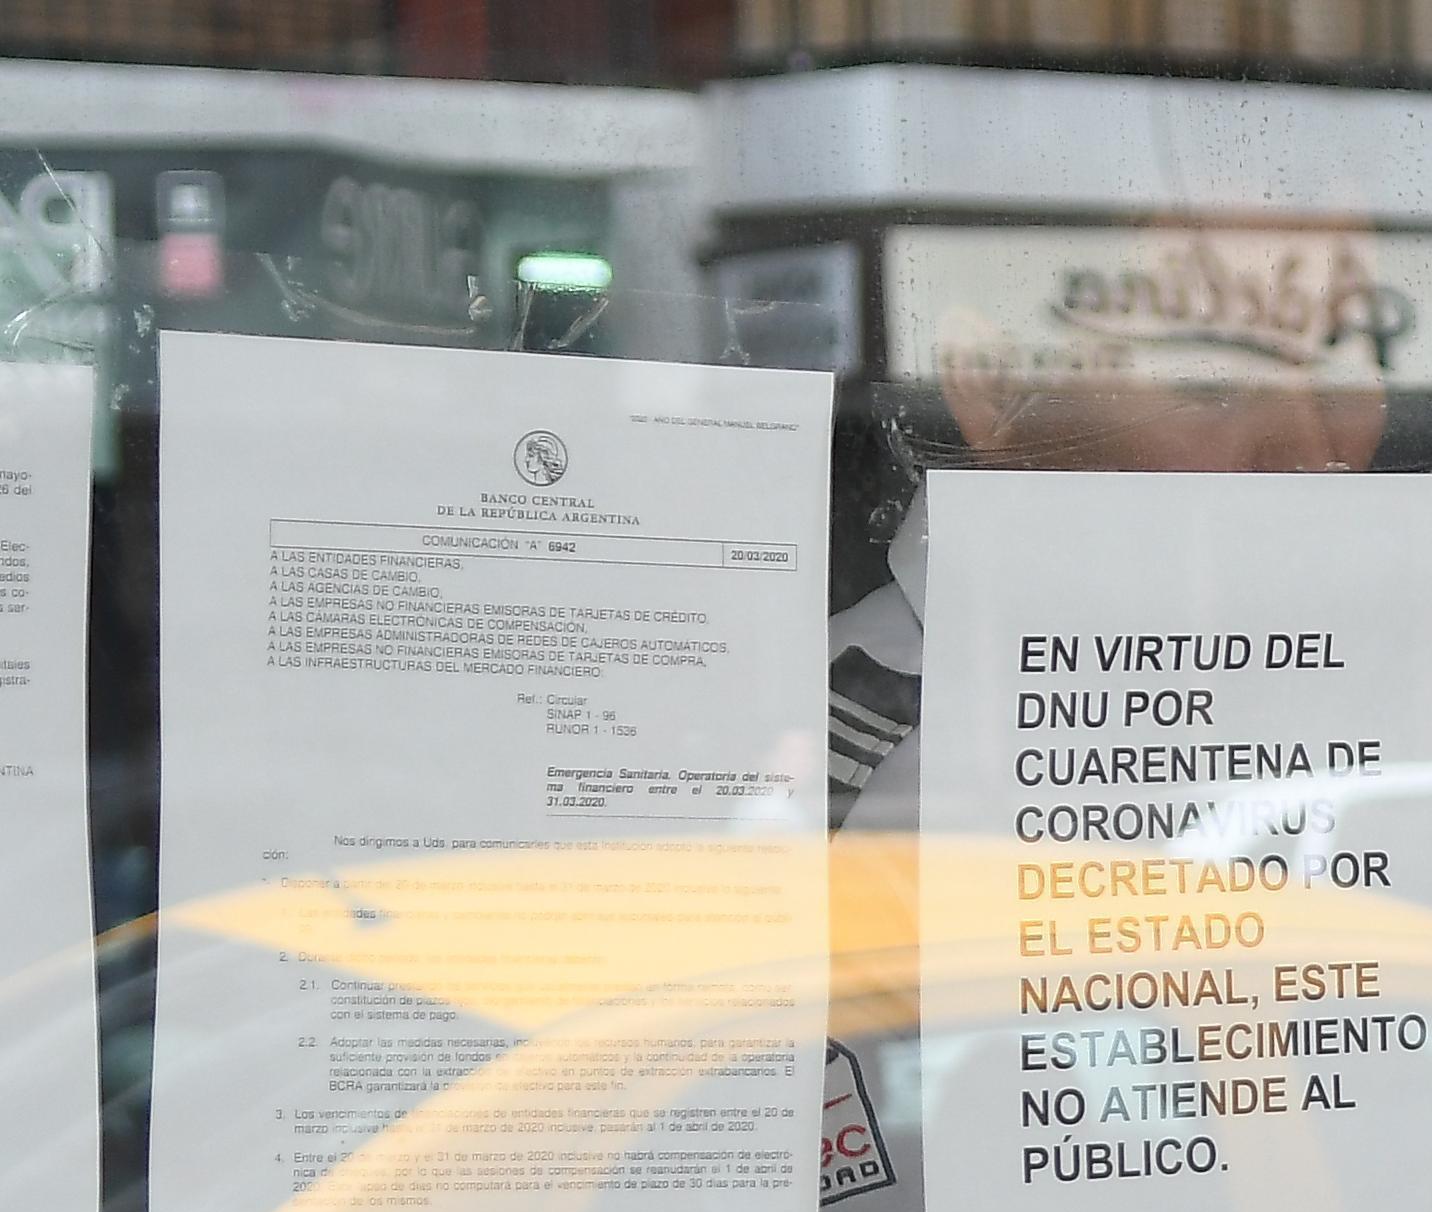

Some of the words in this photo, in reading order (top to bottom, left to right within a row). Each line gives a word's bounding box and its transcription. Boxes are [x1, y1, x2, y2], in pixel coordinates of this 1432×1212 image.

[14, 484, 32, 495] del
[480, 493, 527, 505] BANCO
[531, 496, 595, 509] CENTRAL
[437, 505, 454, 516] DE
[459, 506, 476, 517] LA
[481, 506, 557, 521] REPÚBLICA
[561, 512, 640, 525] ARGENTINA
[422, 533, 519, 550] COMUNICACIÓN
[548, 542, 577, 553] 6942
[270, 551, 278, 561] A
[281, 551, 305, 562] LAS
[308, 552, 376, 565] ENTIDADES
[380, 556, 464, 570] FINANCIERAS,
[730, 550, 789, 563] 20/03/2020
[270, 566, 278, 577] A
[281, 567, 304, 578] LAS
[308, 568, 348, 579] CASAS
[352, 570, 368, 580] DE
[371, 570, 422, 584] CAMBIO,
[270, 582, 278, 592] A
[280, 582, 304, 593] LAS
[308, 583, 370, 596] AGENCIAS
[372, 586, 389, 596] DE
[392, 586, 443, 599] CAMBIO,
[268, 596, 277, 606] A
[280, 596, 304, 607] LAS
[307, 598, 373, 610] EMPRESAS
[376, 600, 394, 611] NO
[398, 601, 480, 614] FINANCIERAS
[483, 605, 546, 617] EMISORAS
[549, 607, 566, 618] DE
[570, 608, 630, 620] TARJETAS
[634, 611, 650, 621] DE
[654, 609, 710, 625] CRÉDITO,
[268, 611, 276, 622] A
[280, 612, 303, 623] LAS
[306, 611, 366, 625] CÁMARAS
[369, 613, 463, 629] ELECTRÓNICAS
[467, 619, 484, 630] DE
[488, 618, 588, 635] COMPENSACIÓN,
[267, 626, 276, 637] A
[280, 627, 302, 638] LAS
[306, 628, 372, 640] EMPRESAS
[376, 630, 494, 645] ADMINISTRADORAS
[498, 635, 514, 645] DE
[518, 635, 558, 647] REDES
[562, 637, 576, 648] DE
[580, 638, 637, 650] CAJEROS
[640, 638, 730, 654] AUTOMÁTICOS,
[267, 641, 276, 652] A
[278, 642, 302, 652] LAS
[306, 643, 372, 655] EMPRESAS
[376, 645, 394, 656] NO
[397, 646, 479, 659] FINANCIERAS
[482, 649, 545, 661] EMISORAS
[548, 651, 564, 661] DE
[568, 652, 629, 664] TARJETAS
[633, 654, 648, 664] DE
[652, 654, 706, 667] COMPRA,
[1019, 633, 1080, 674] EN
[1093, 632, 1251, 672] VIRTUD
[1265, 631, 1345, 670] DEL
[266, 656, 274, 666] A
[278, 656, 301, 667] LAS
[305, 657, 432, 672] INFRAESTRUCTURAS
[436, 662, 460, 673] DEL
[463, 663, 524, 675] MERCADO
[528, 665, 604, 678] FINANCIERO:
[517, 693, 543, 705] Ref.:
[546, 694, 588, 706] Circular
[1017, 690, 1110, 731] DNU
[1123, 688, 1214, 728] POR
[546, 708, 582, 720] SINAP
[602, 710, 617, 721] 96
[546, 723, 589, 735] RUNOR
[611, 725, 637, 736] 1536
[1016, 741, 1314, 787] CUARENTENA
[1327, 740, 1382, 778] DE
[547, 767, 612, 780] Emergencia
[618, 768, 671, 780] Sanitaria.
[678, 770, 736, 783] Operatoria
[742, 771, 758, 783] del
[764, 772, 795, 783] siste-
[546, 783, 563, 793] ma
[578, 782, 633, 794] financiero
[648, 784, 678, 795] entre
[691, 783, 702, 795] el
[546, 796, 607, 808] 31.03.2020.
[1015, 798, 1337, 844] CORONAVIRUS
[1018, 855, 1289, 901] DECRETADO
[1305, 852, 1391, 890] POR
[1019, 919, 1073, 957] EL
[1088, 911, 1266, 954] ESTADO
[1019, 969, 1261, 1014] NACIONAL,
[1273, 963, 1380, 1002] ESTE
[330, 1011, 350, 1020] con
[354, 1009, 364, 1020] el
[367, 1010, 409, 1020] sistema
[412, 1010, 425, 1020] de
[428, 1011, 457, 1023] pago.
[1021, 1014, 1428, 1070] ESTABLECIMIENTO
[1021, 1089, 1085, 1127] NO
[1100, 1078, 1288, 1123] ATIENDE
[1301, 1074, 1356, 1110] AL
[1023, 1135, 1230, 1184] PÚBLICO.
